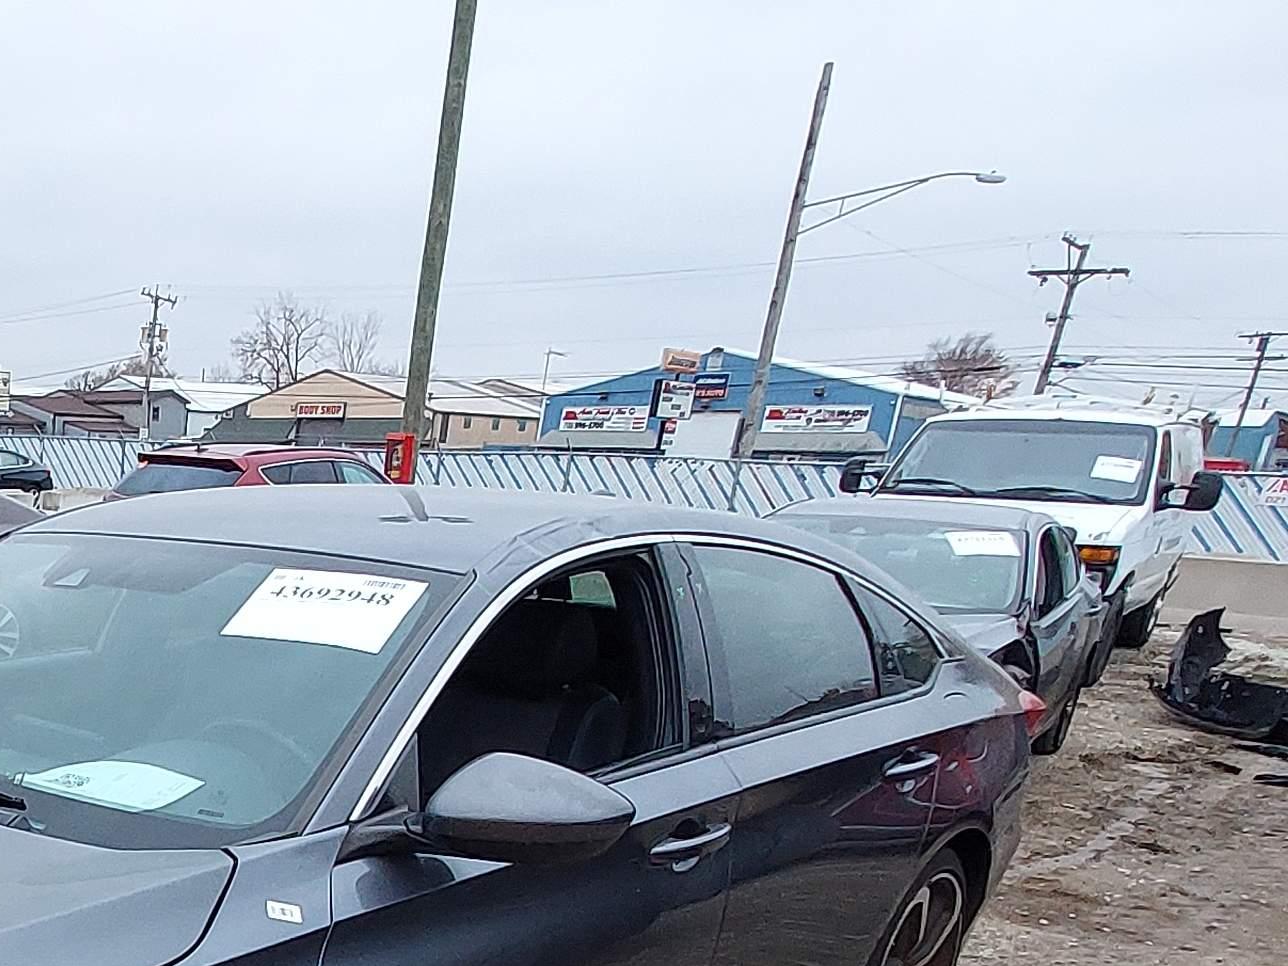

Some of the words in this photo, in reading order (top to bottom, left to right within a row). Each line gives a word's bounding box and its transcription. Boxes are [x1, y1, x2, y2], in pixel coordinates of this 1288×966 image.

[298, 405, 319, 415] BODY
[320, 405, 342, 415] SHOP
[270, 585, 395, 606] 43692948
